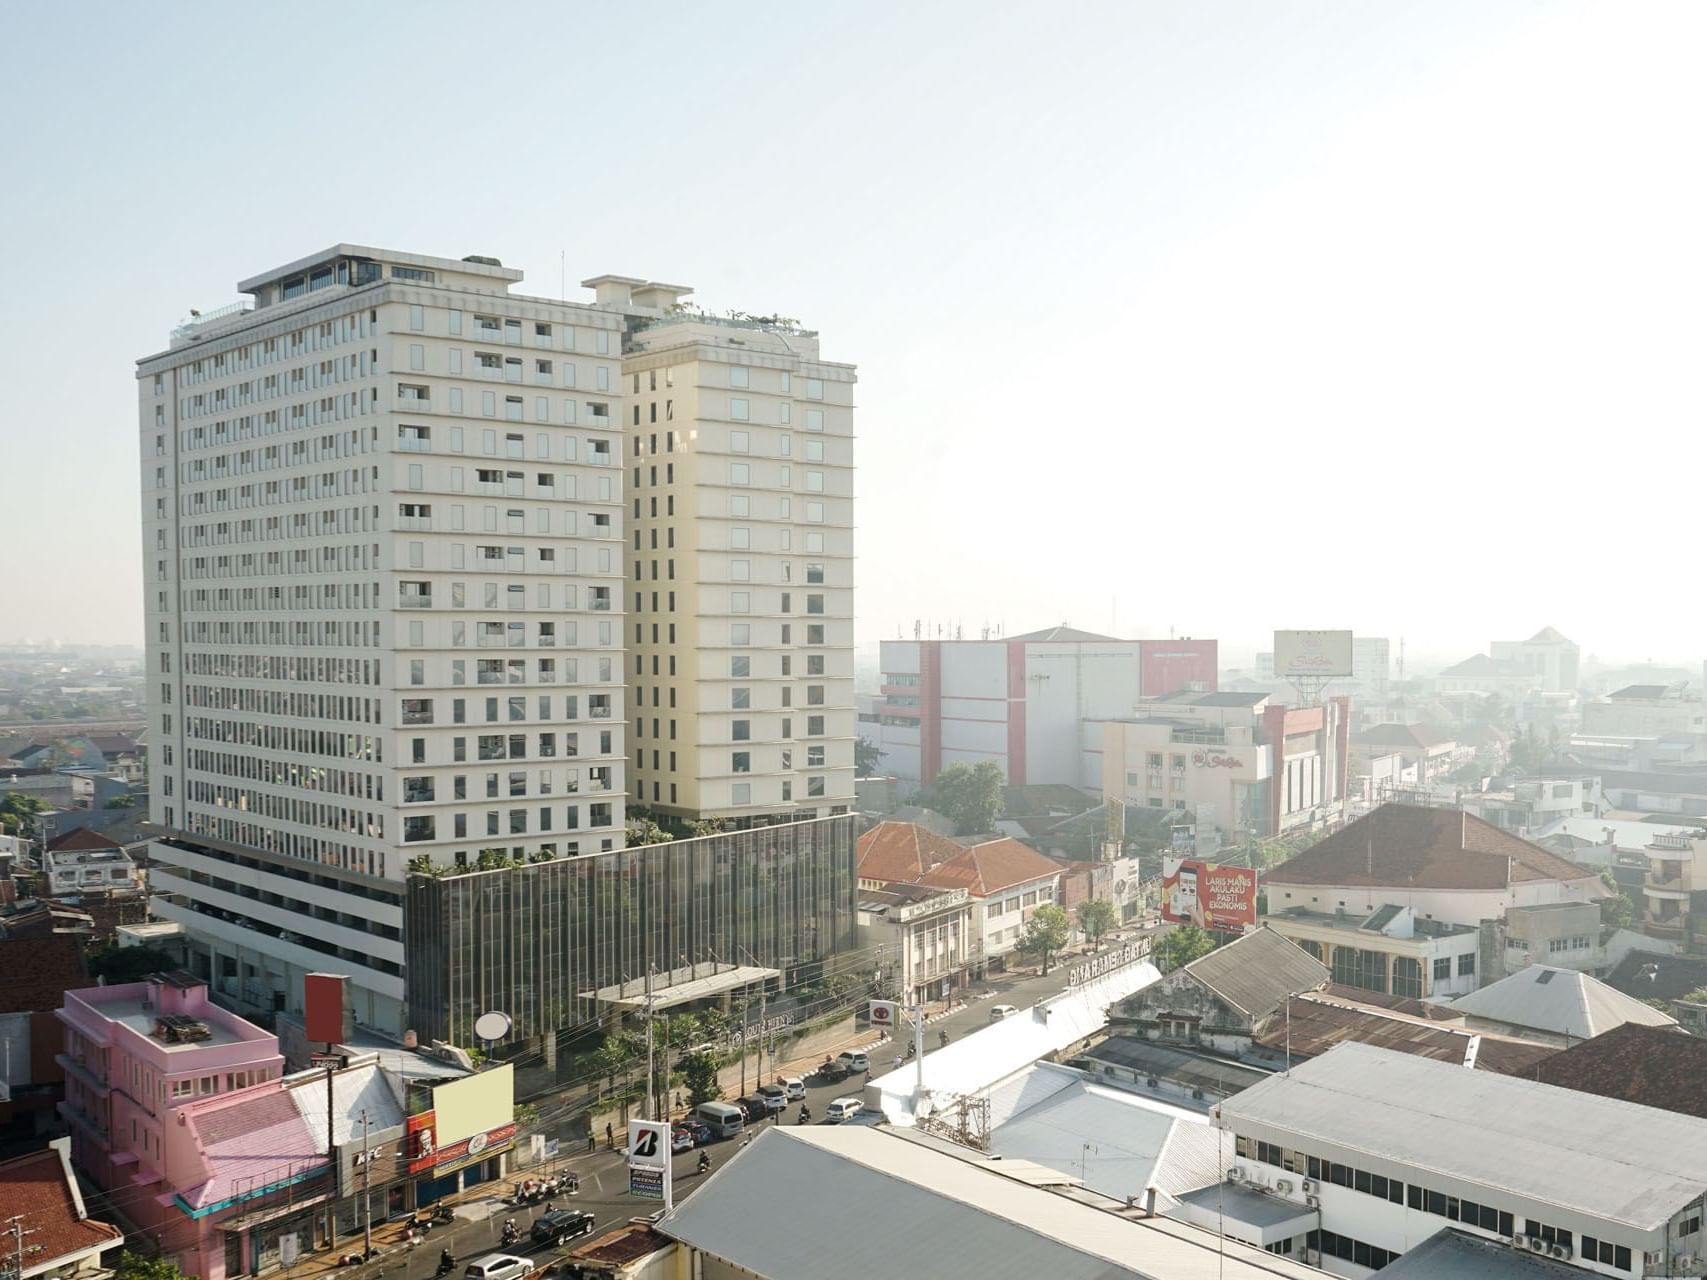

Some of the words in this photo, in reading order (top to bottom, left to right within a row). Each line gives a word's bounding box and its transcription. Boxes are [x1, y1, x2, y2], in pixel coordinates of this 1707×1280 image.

[1205, 877, 1226, 886] LARIS
[1210, 885, 1245, 894] AKULAKU
[1216, 894, 1238, 902] PASTI
[1209, 901, 1247, 910] EKONOMIS
[356, 1146, 383, 1165] KFC
